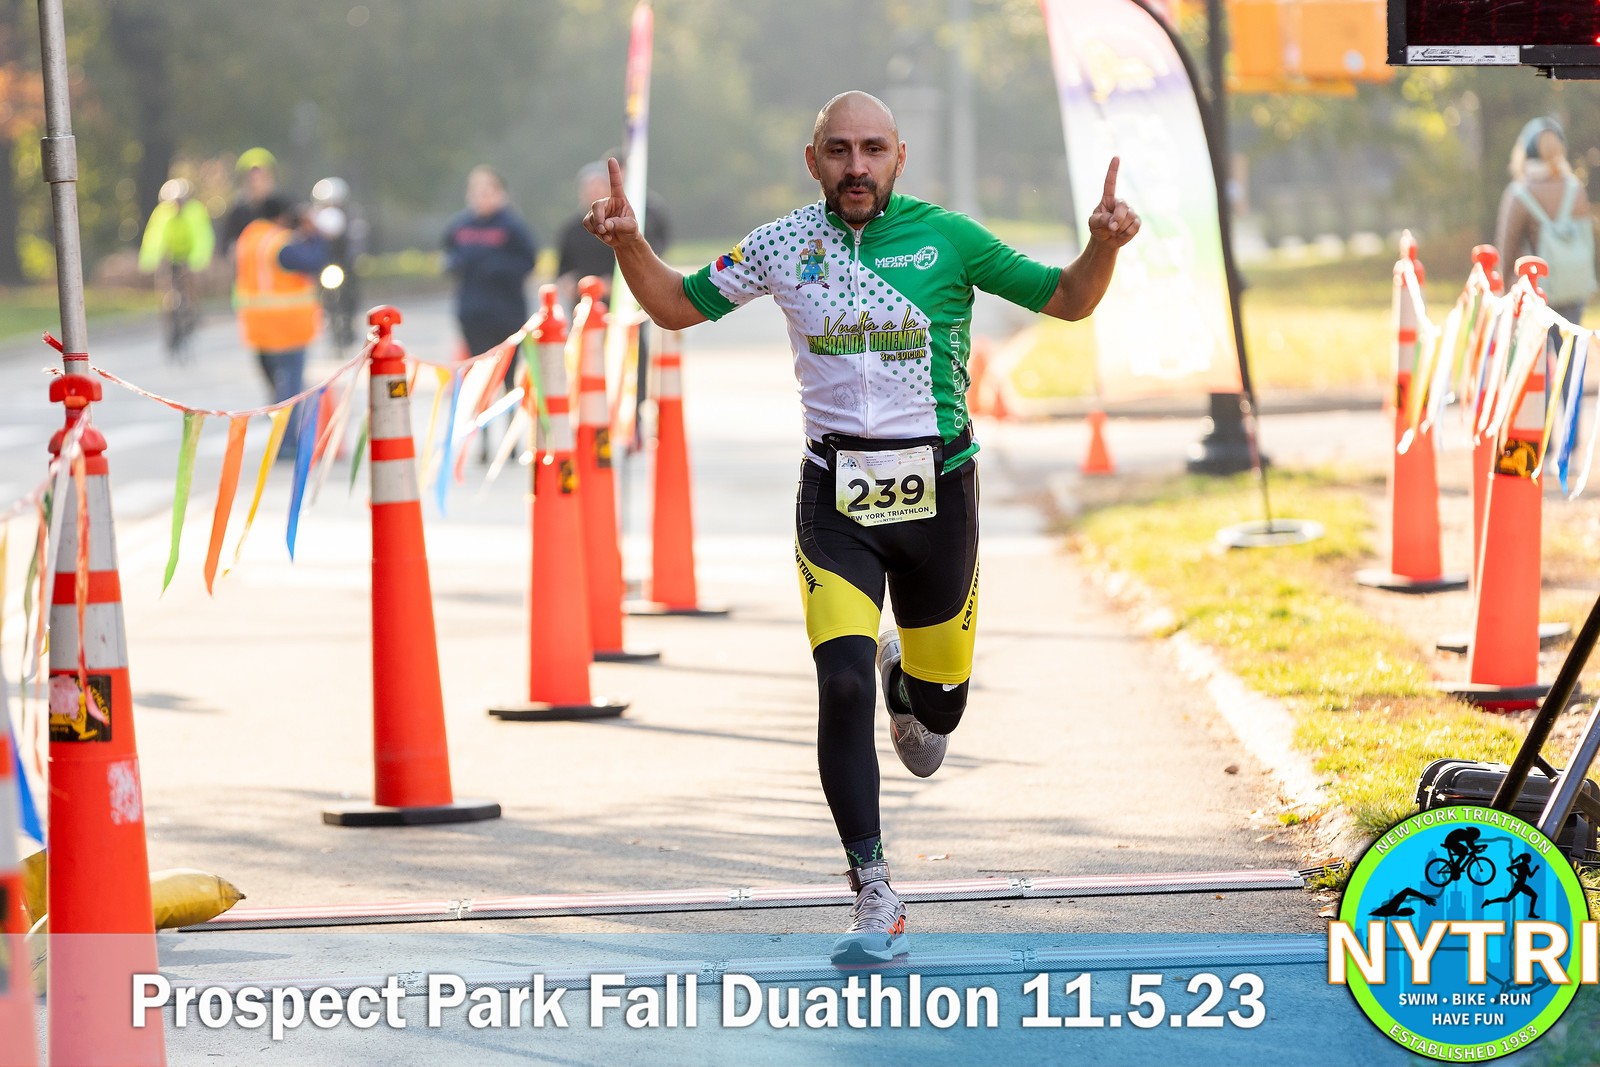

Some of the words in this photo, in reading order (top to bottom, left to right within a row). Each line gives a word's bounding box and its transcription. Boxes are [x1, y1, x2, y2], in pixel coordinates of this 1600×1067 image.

[875, 253, 931, 266] MORONA
[824, 311, 879, 340] Vuelta
[882, 320, 897, 330] a
[901, 307, 919, 330] la
[869, 327, 927, 352] ORIENTAL
[847, 474, 925, 513] 239
[865, 512, 886, 520] YORK
[887, 506, 930, 517] TRIATHLON
